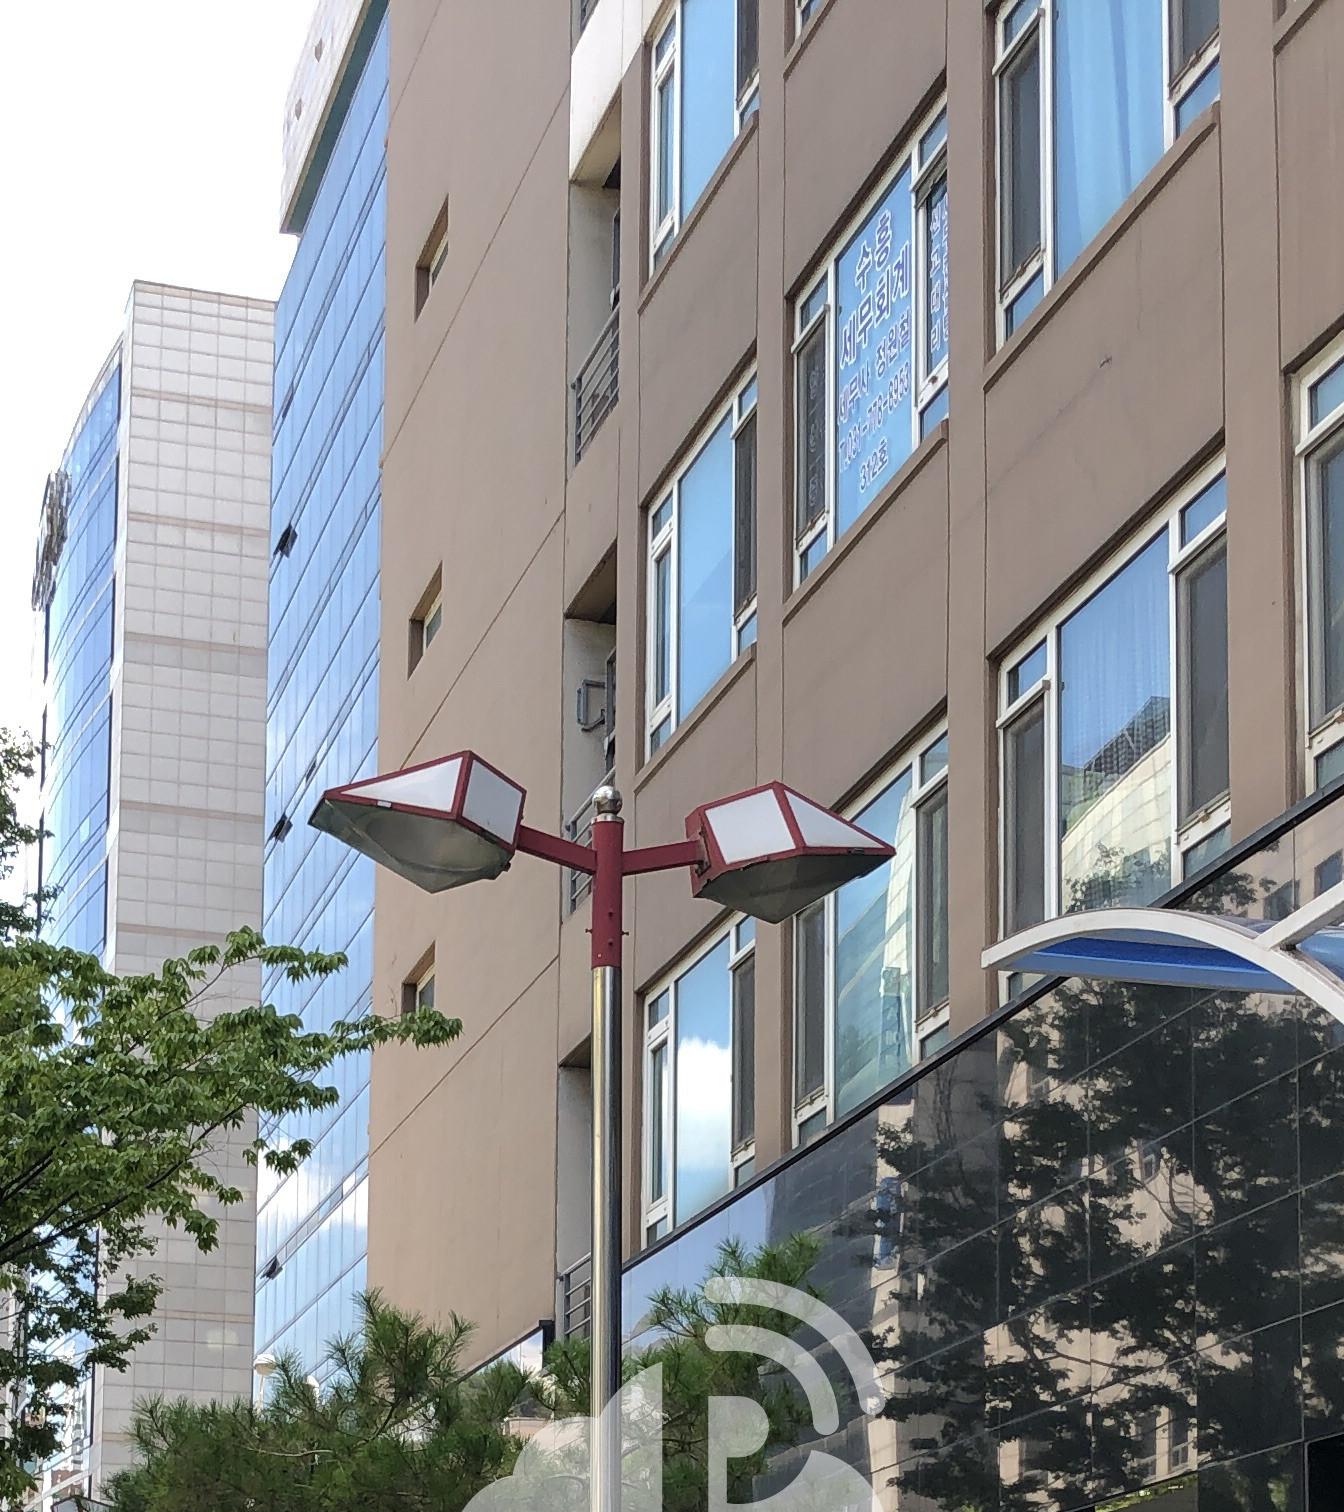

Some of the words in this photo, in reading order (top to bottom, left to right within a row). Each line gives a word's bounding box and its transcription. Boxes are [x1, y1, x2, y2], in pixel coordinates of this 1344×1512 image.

[855, 209, 892, 295] 수흥
[840, 240, 912, 369] 세무회계
[838, 360, 871, 425] 세무사
[860, 437, 889, 494] 312호
